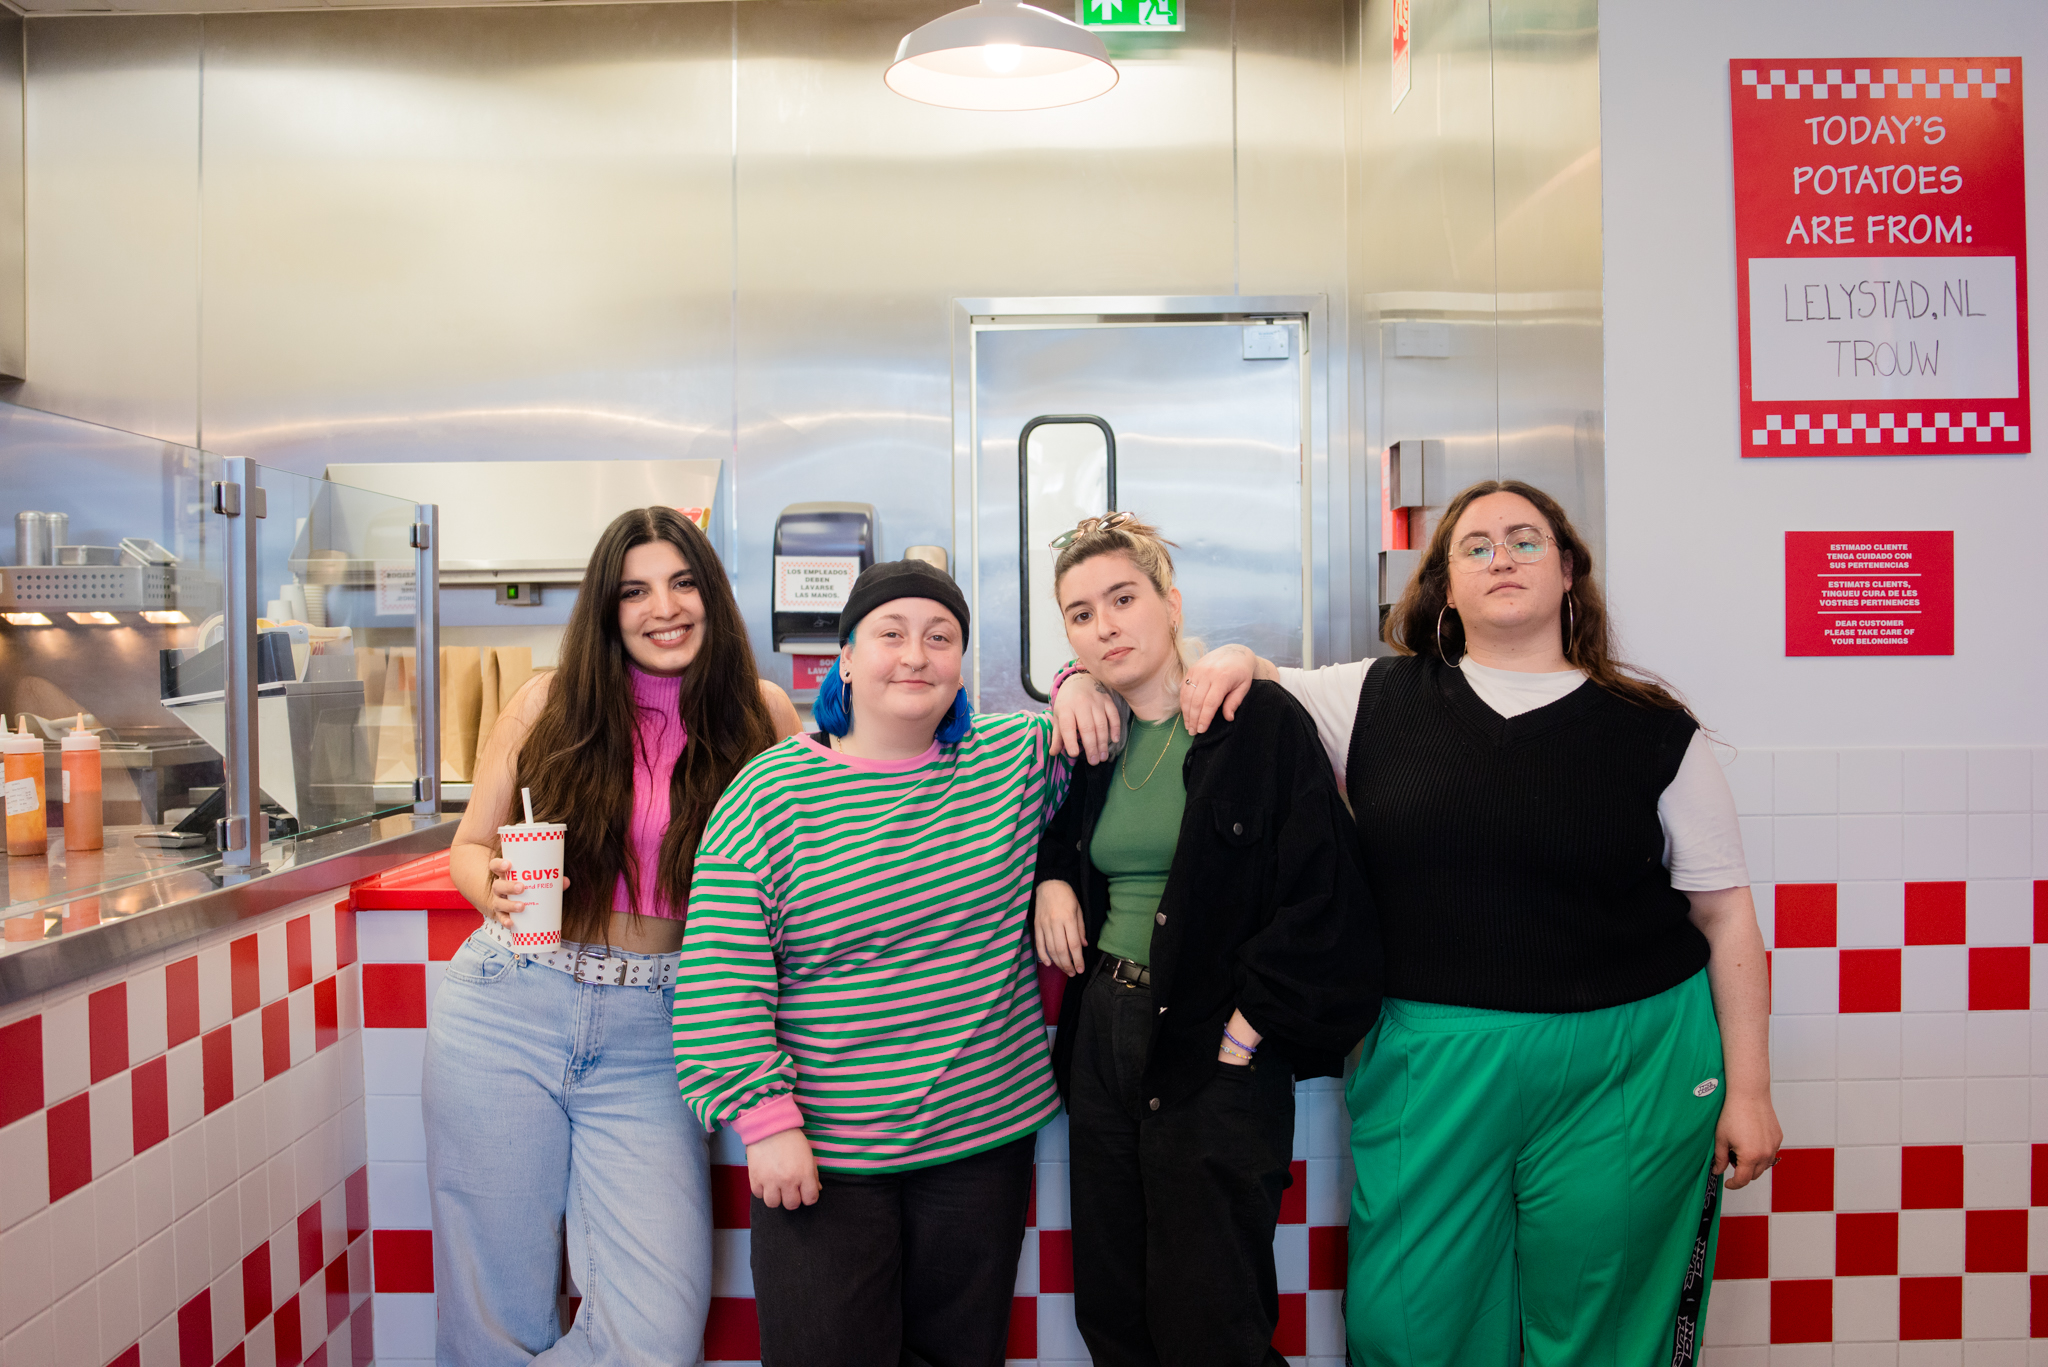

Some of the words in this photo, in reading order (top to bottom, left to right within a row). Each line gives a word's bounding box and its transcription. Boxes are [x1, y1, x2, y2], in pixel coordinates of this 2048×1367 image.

[1805, 115, 1946, 145] TODAY'S
[1793, 165, 1963, 195] POTATOES
[1786, 215, 1855, 245] ARE
[1867, 214, 1973, 244] FROM:
[1827, 340, 1939, 377] TROUW
[1828, 581, 1870, 589] ESTIMATS
[1872, 581, 1911, 589] CLIENTS,
[505, 870, 518, 881] VE
[522, 868, 559, 881] GUYS
